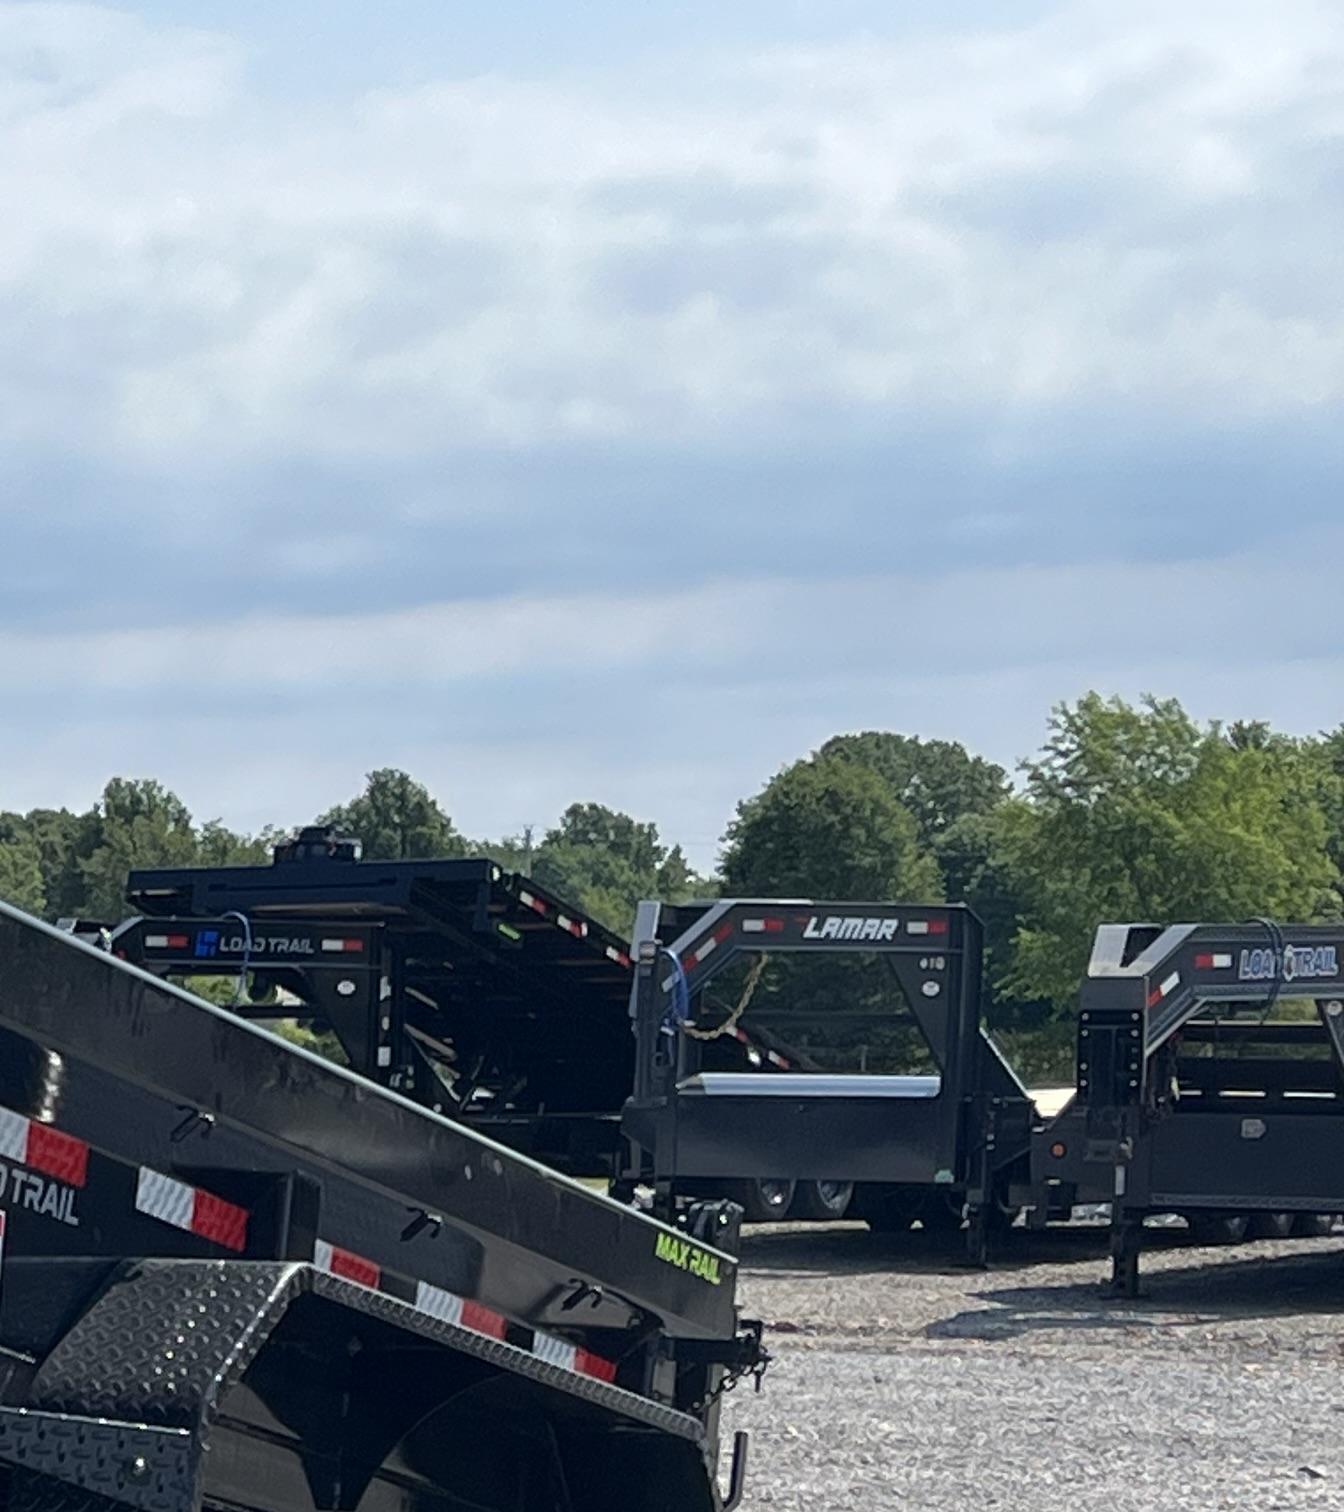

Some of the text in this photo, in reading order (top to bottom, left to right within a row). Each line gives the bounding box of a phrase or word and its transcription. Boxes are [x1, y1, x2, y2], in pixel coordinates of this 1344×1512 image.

[803, 916, 899, 940] LAMAR
[268, 937, 315, 954] TRAIL
[1238, 946, 1339, 979] LOA TRAIL
[12, 1168, 80, 1226] TRAIL
[655, 1232, 721, 1285] MAX RAIL
